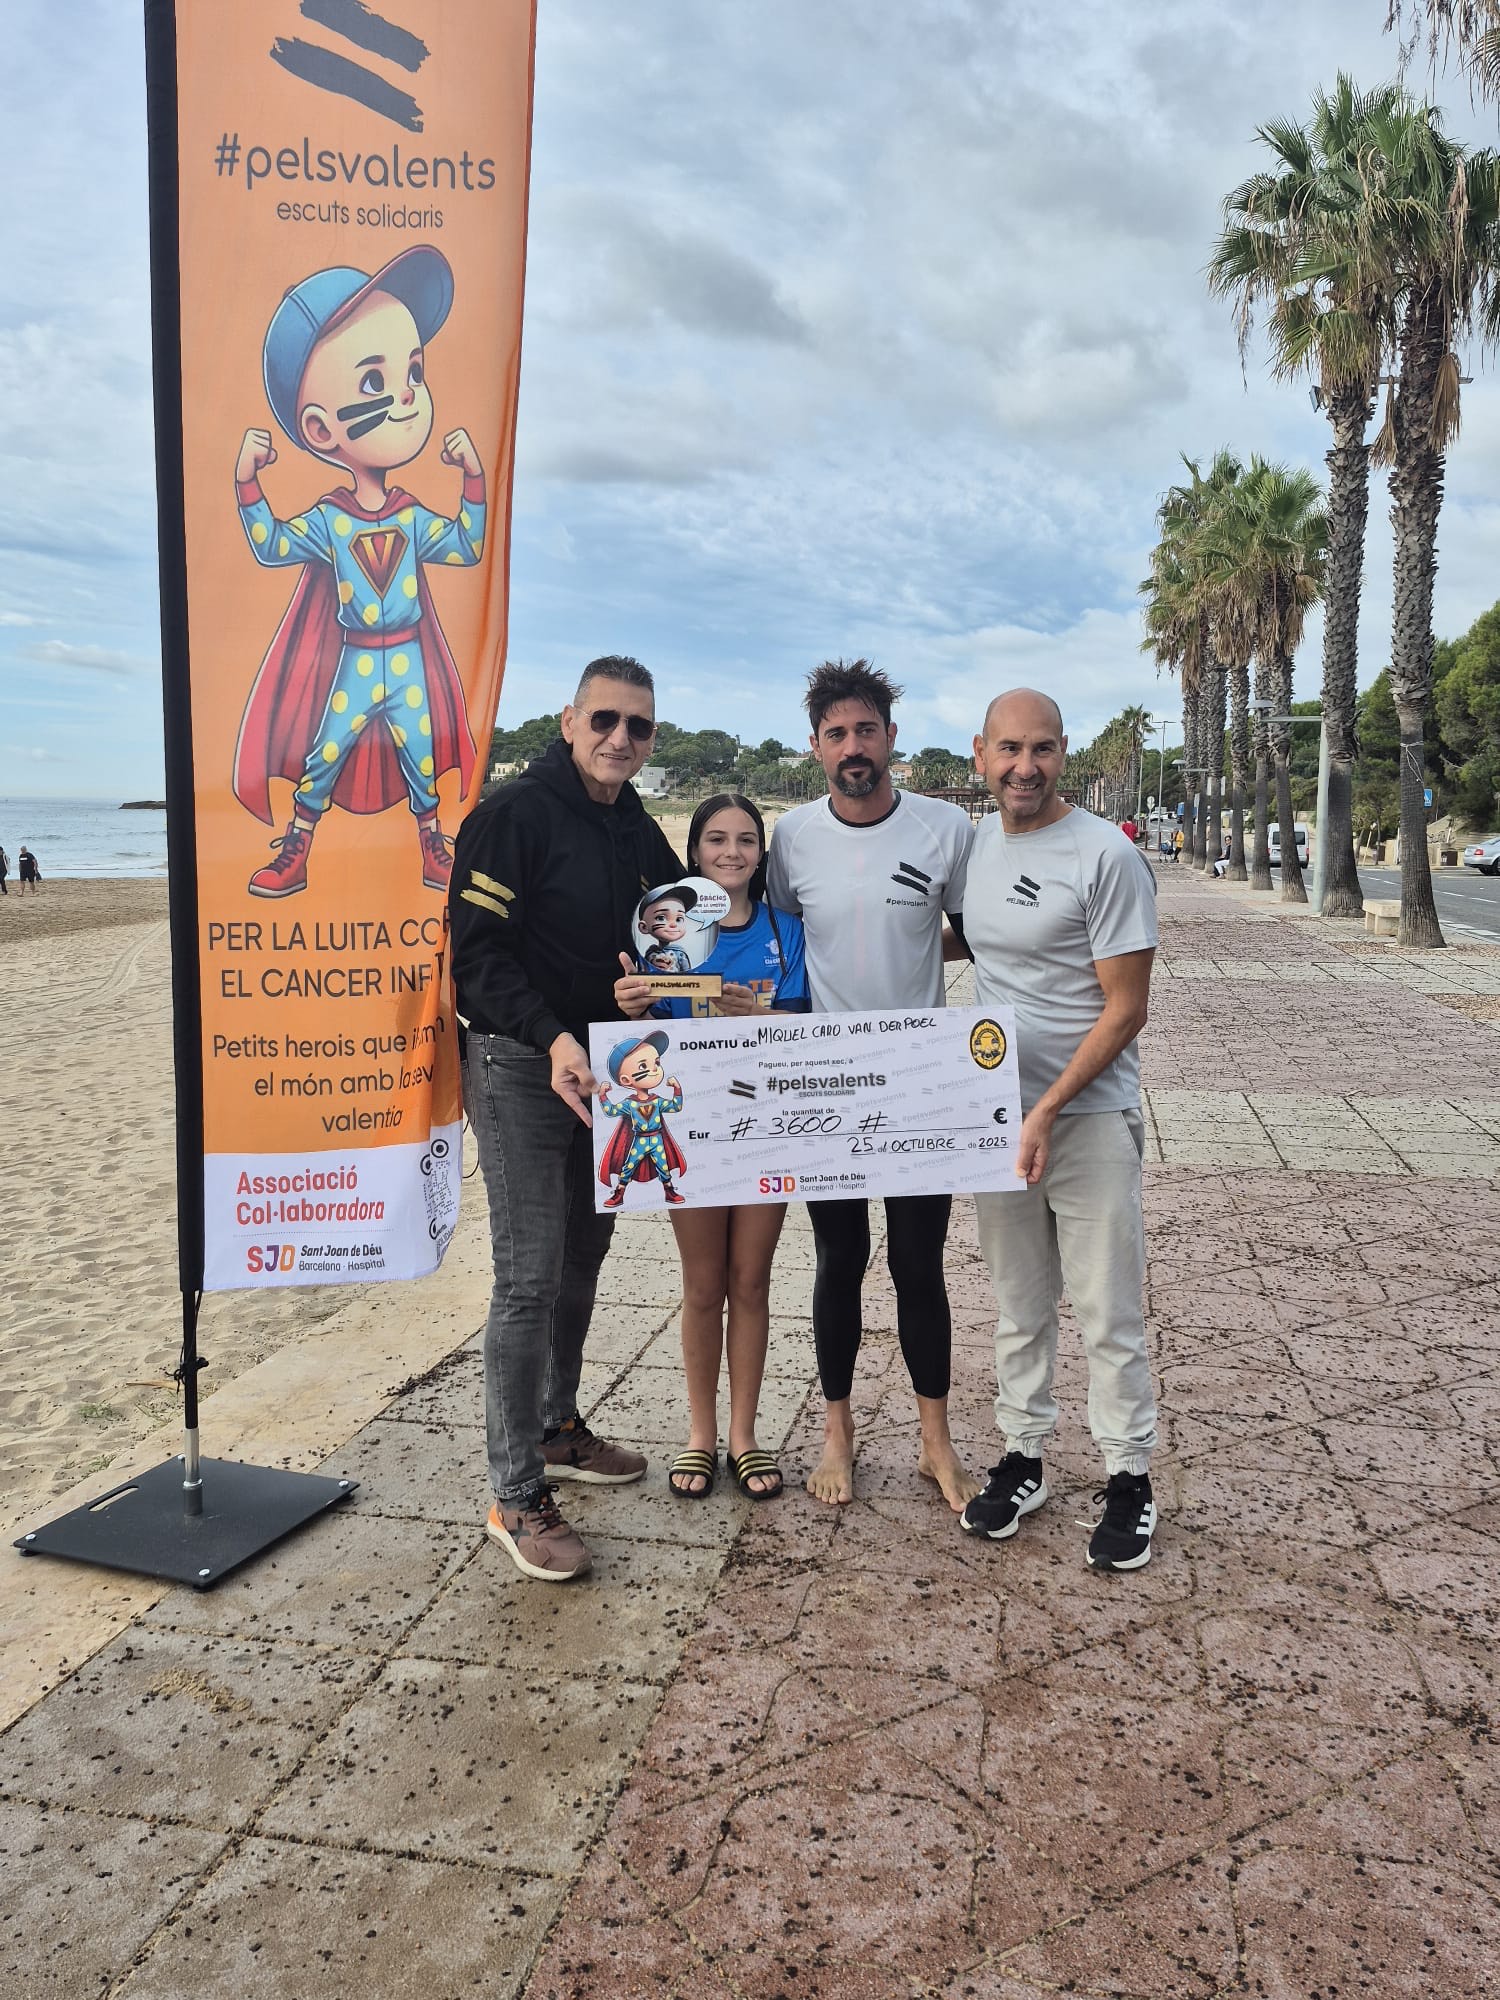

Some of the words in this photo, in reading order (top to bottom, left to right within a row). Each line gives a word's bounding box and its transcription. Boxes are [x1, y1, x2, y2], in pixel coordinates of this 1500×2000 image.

[214, 132, 496, 191] #pelsvalents
[276, 200, 350, 225] escuts
[356, 203, 444, 229] solidaris
[208, 921, 262, 951] PER
[272, 921, 307, 951] LA
[315, 920, 392, 951] LUITA
[221, 968, 253, 998] EL
[261, 968, 382, 998] CANCER
[757, 1026, 808, 1045] MIQUEL
[848, 1021, 872, 1035] VAN
[213, 1033, 279, 1058] Petits
[285, 1034, 355, 1057] herois
[362, 1034, 407, 1060] que
[679, 1039, 738, 1051] DONATIU
[742, 1039, 757, 1048] de
[758, 1061, 789, 1070] Pagueu,
[790, 1061, 803, 1069] per
[805, 1058, 830, 1067] aquest
[254, 1071, 274, 1096] el
[281, 1073, 333, 1096] món
[340, 1068, 394, 1094] amb
[411, 1063, 434, 1086] sev
[766, 1072, 887, 1095] #pelsvalents
[322, 1105, 403, 1132] valentia
[790, 1107, 824, 1117] quantitat
[993, 1107, 1007, 1125] €
[688, 1130, 710, 1139] Eur
[768, 1115, 842, 1135] 3600
[847, 1136, 874, 1153] 25
[891, 1138, 956, 1152] OCTUBRE
[978, 1136, 1008, 1148] 2025
[236, 1164, 358, 1195] Associació
[759, 1176, 796, 1193] SJD
[799, 1175, 817, 1183] Sant
[819, 1174, 838, 1182] Joan
[840, 1173, 849, 1181] de
[800, 1184, 834, 1192] Barcelona
[839, 1182, 866, 1191] Hospital
[236, 1197, 385, 1225] Col·laboradora
[247, 1244, 295, 1273] SJD
[300, 1245, 323, 1257] Sant
[325, 1245, 349, 1257] Joan
[351, 1245, 361, 1256] de
[362, 1245, 382, 1256] Déu
[299, 1259, 341, 1271] Barcelona
[347, 1258, 385, 1271] Hospital
